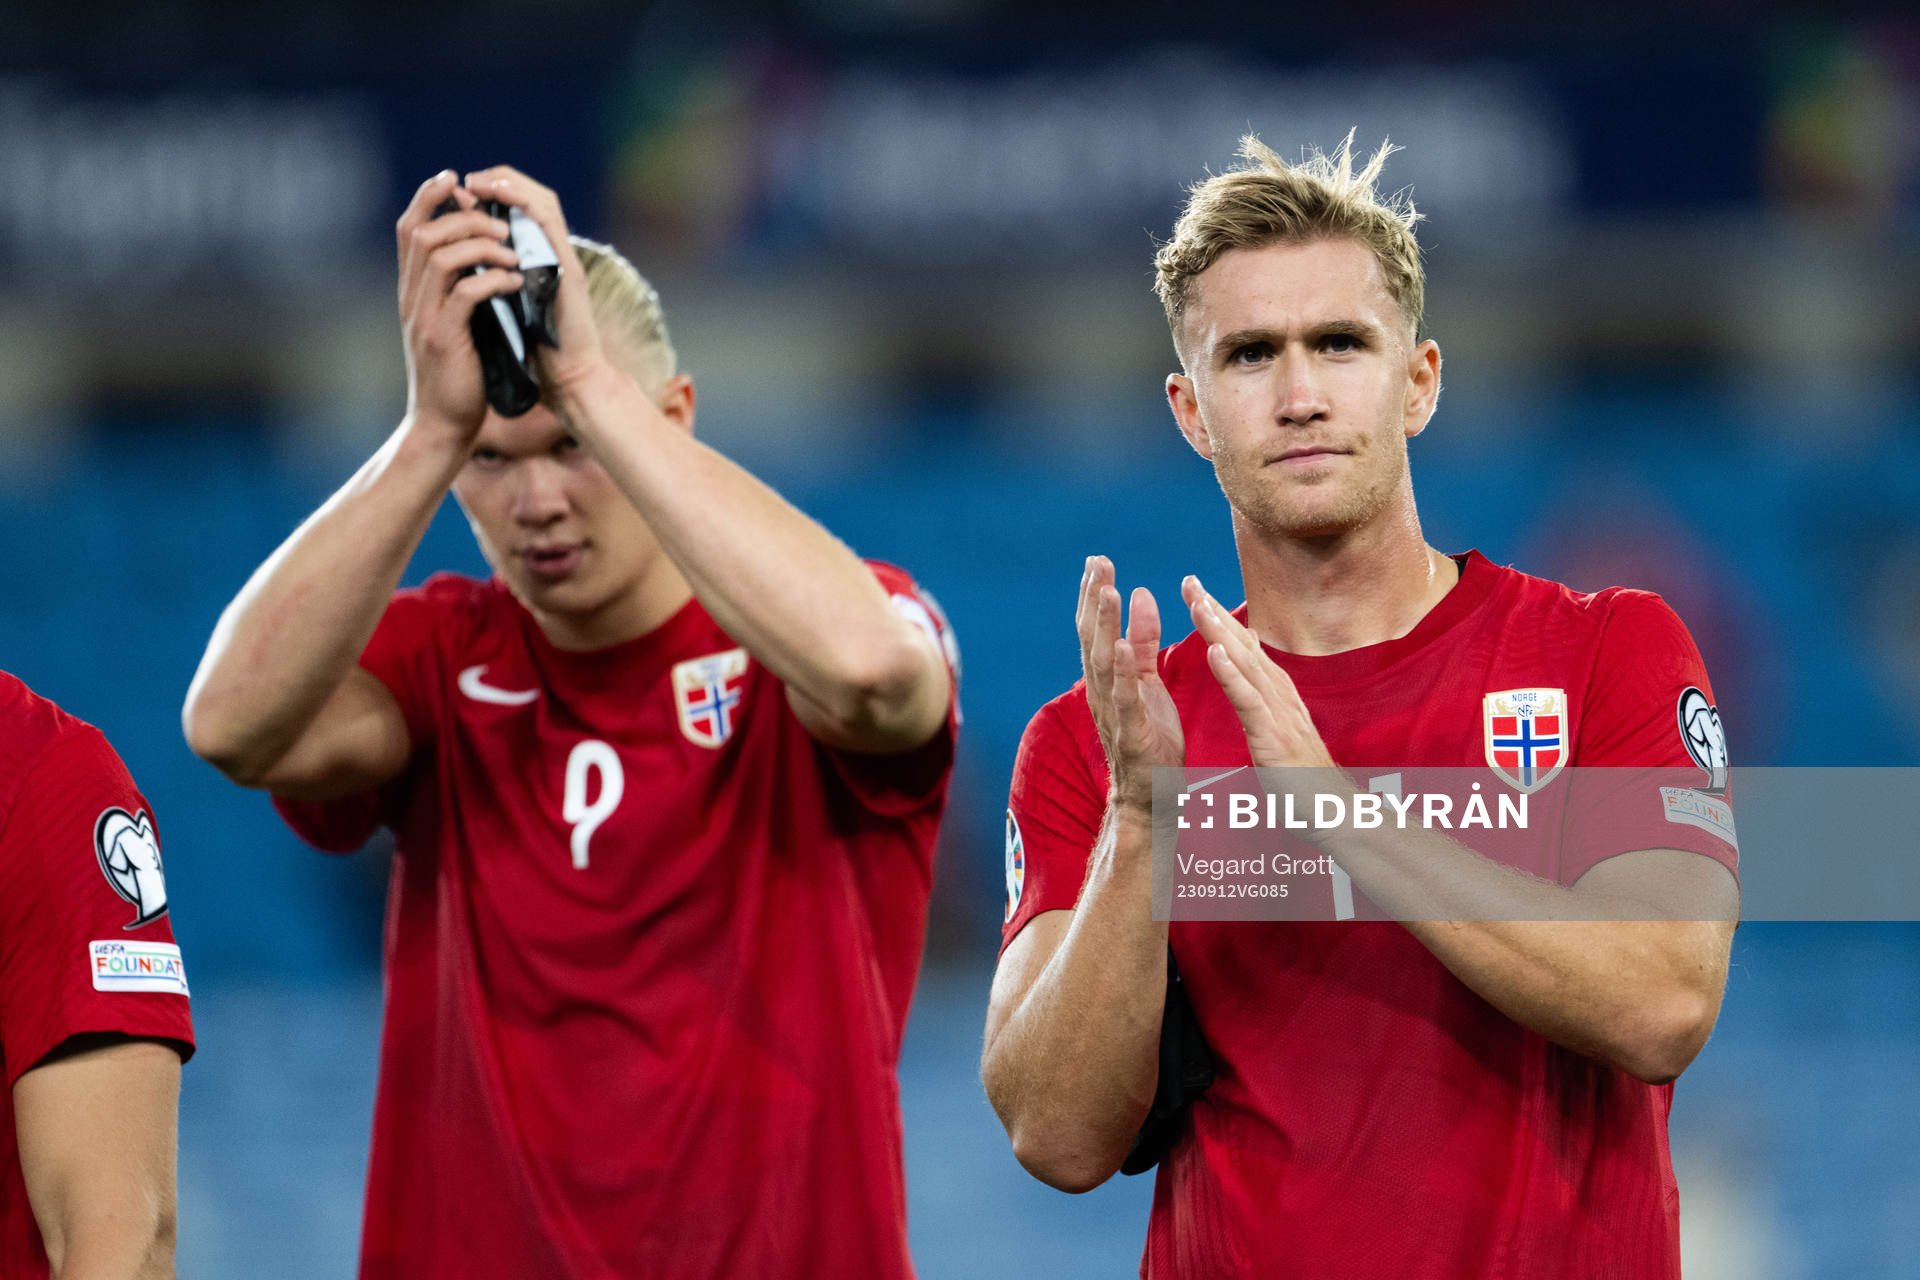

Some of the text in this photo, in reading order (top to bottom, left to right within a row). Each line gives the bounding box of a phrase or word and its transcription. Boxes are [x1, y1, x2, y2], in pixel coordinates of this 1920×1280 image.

[1512, 692, 1537, 702] NORGE
[563, 739, 624, 869] 9
[1665, 789, 1694, 798] UEFA
[1667, 796, 1734, 831] FOUND
